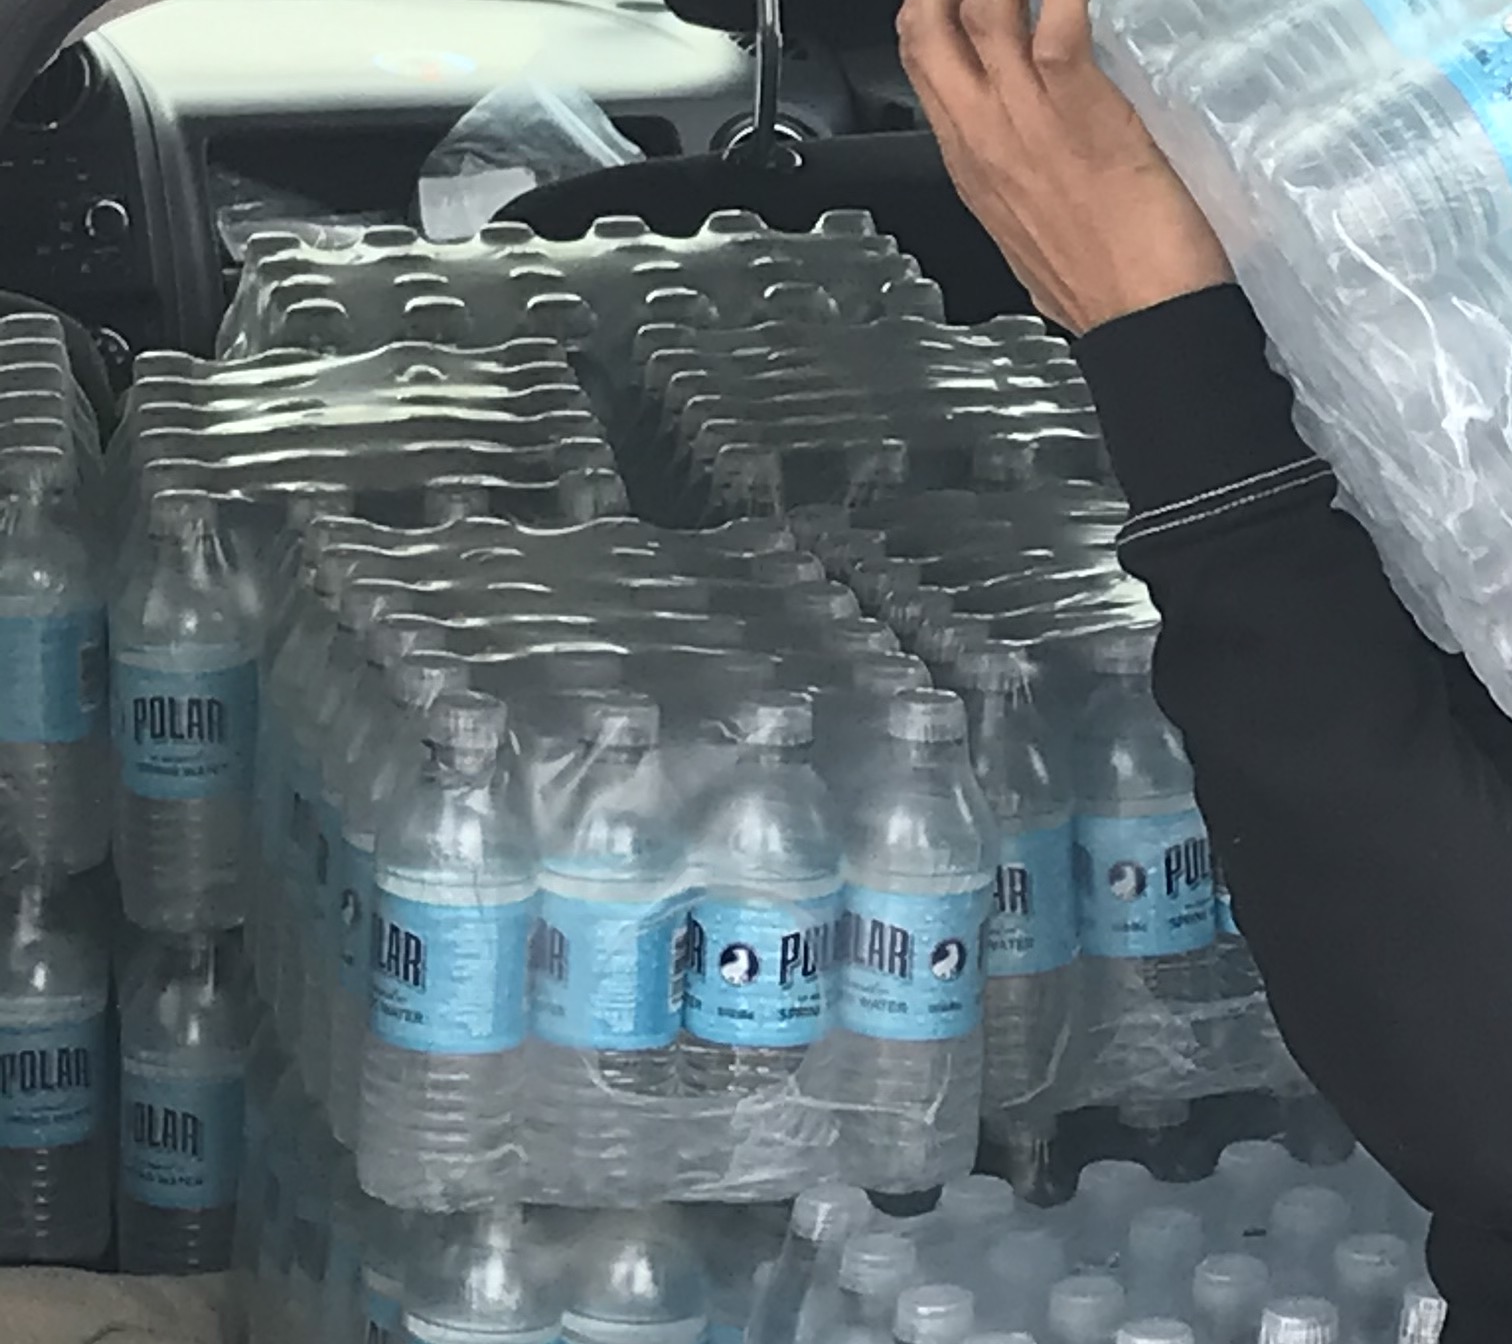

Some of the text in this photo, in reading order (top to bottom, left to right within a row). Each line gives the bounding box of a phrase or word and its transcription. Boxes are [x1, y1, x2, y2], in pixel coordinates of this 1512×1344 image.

[372, 912, 427, 989] LAR
[851, 912, 912, 981] LAR
[134, 1101, 203, 1160] OLAR
